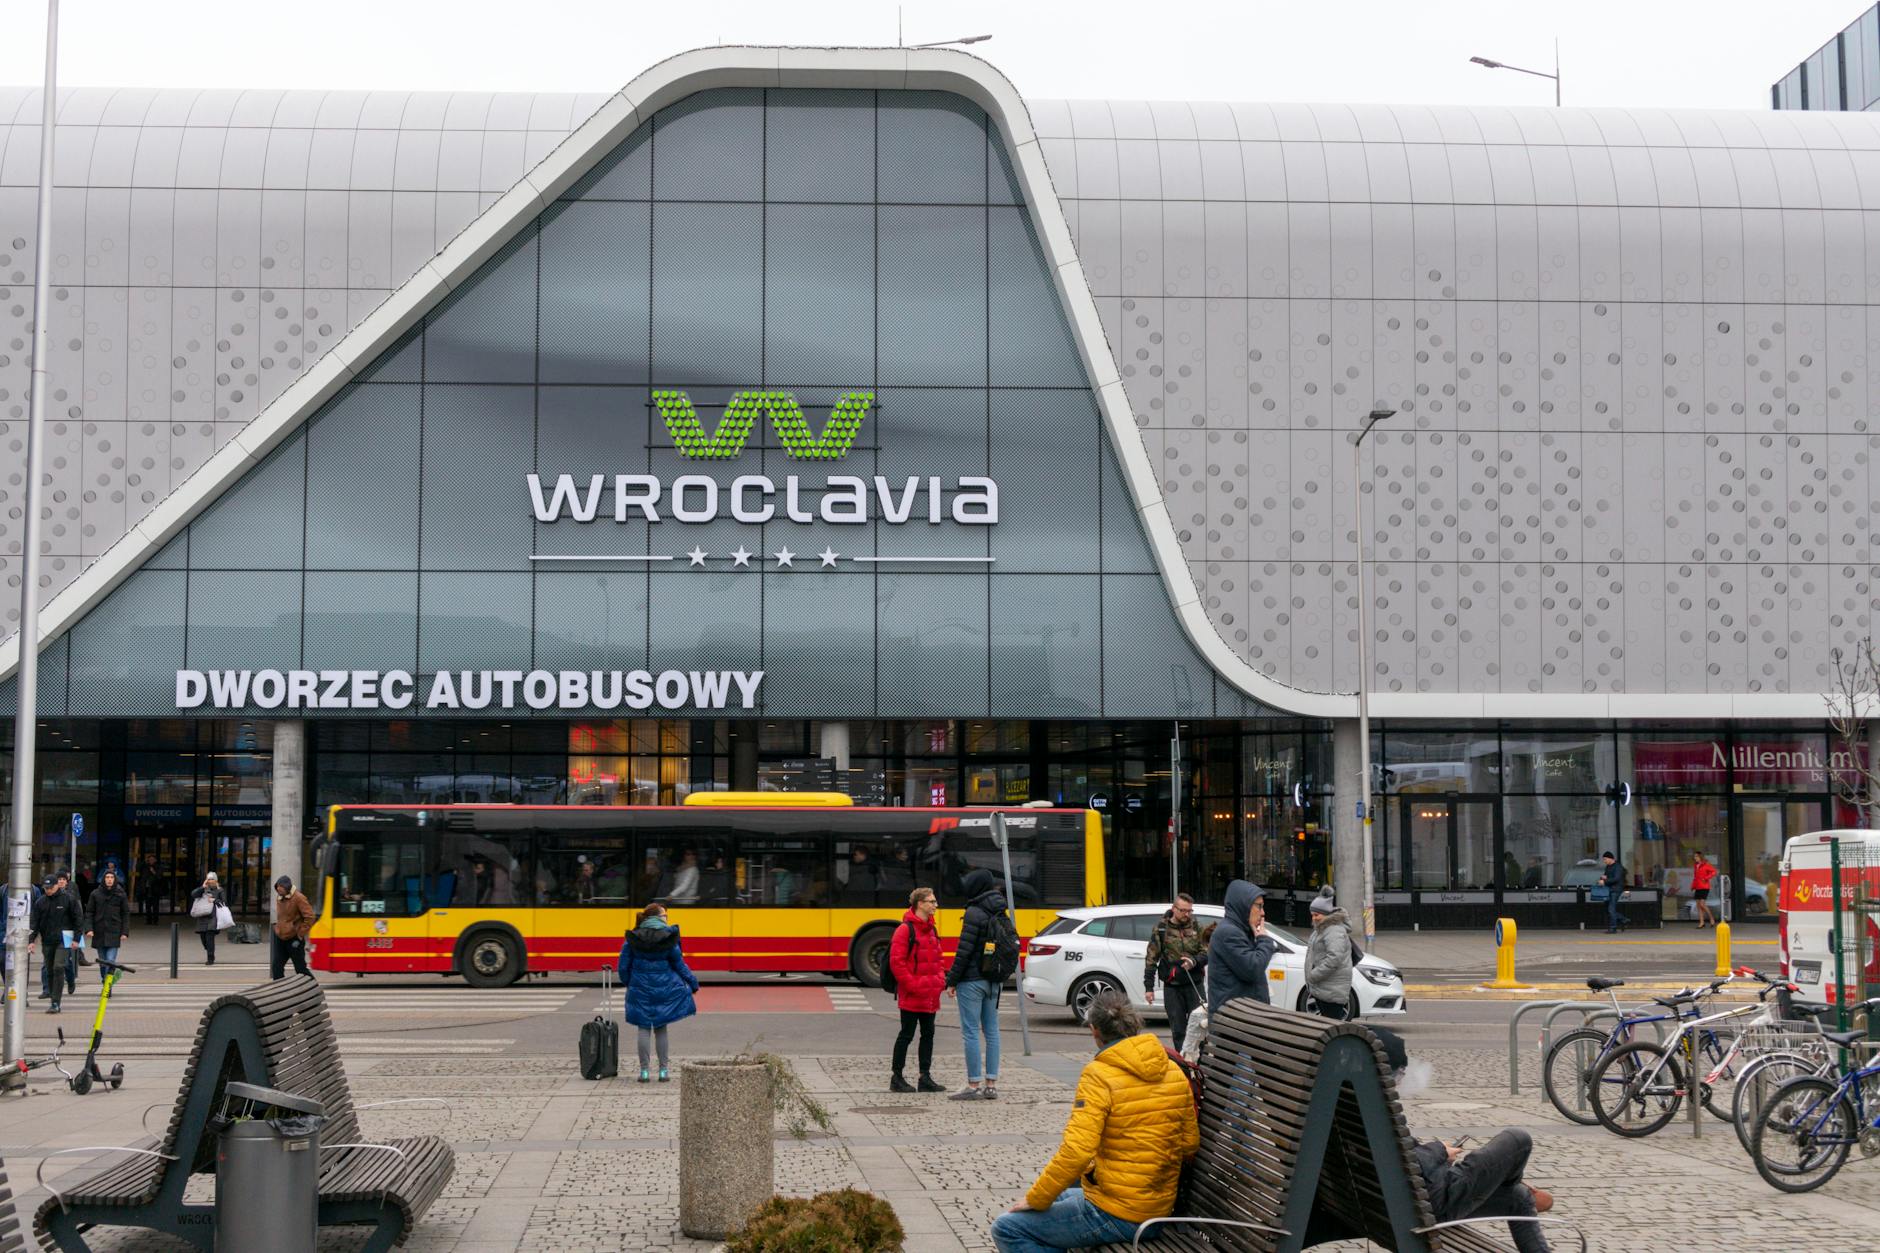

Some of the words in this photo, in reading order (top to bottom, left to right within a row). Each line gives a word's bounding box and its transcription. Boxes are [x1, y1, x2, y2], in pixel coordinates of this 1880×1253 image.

[175, 669, 414, 710] DWORZEC
[425, 669, 765, 710] AUTOBUSOWY
[1253, 756, 1294, 771] Vincent
[1532, 753, 1577, 769] Vincent
[135, 809, 182, 817] DWORZEC
[213, 809, 273, 817] AUTOBUSOW
[1064, 951, 1084, 962] 196
